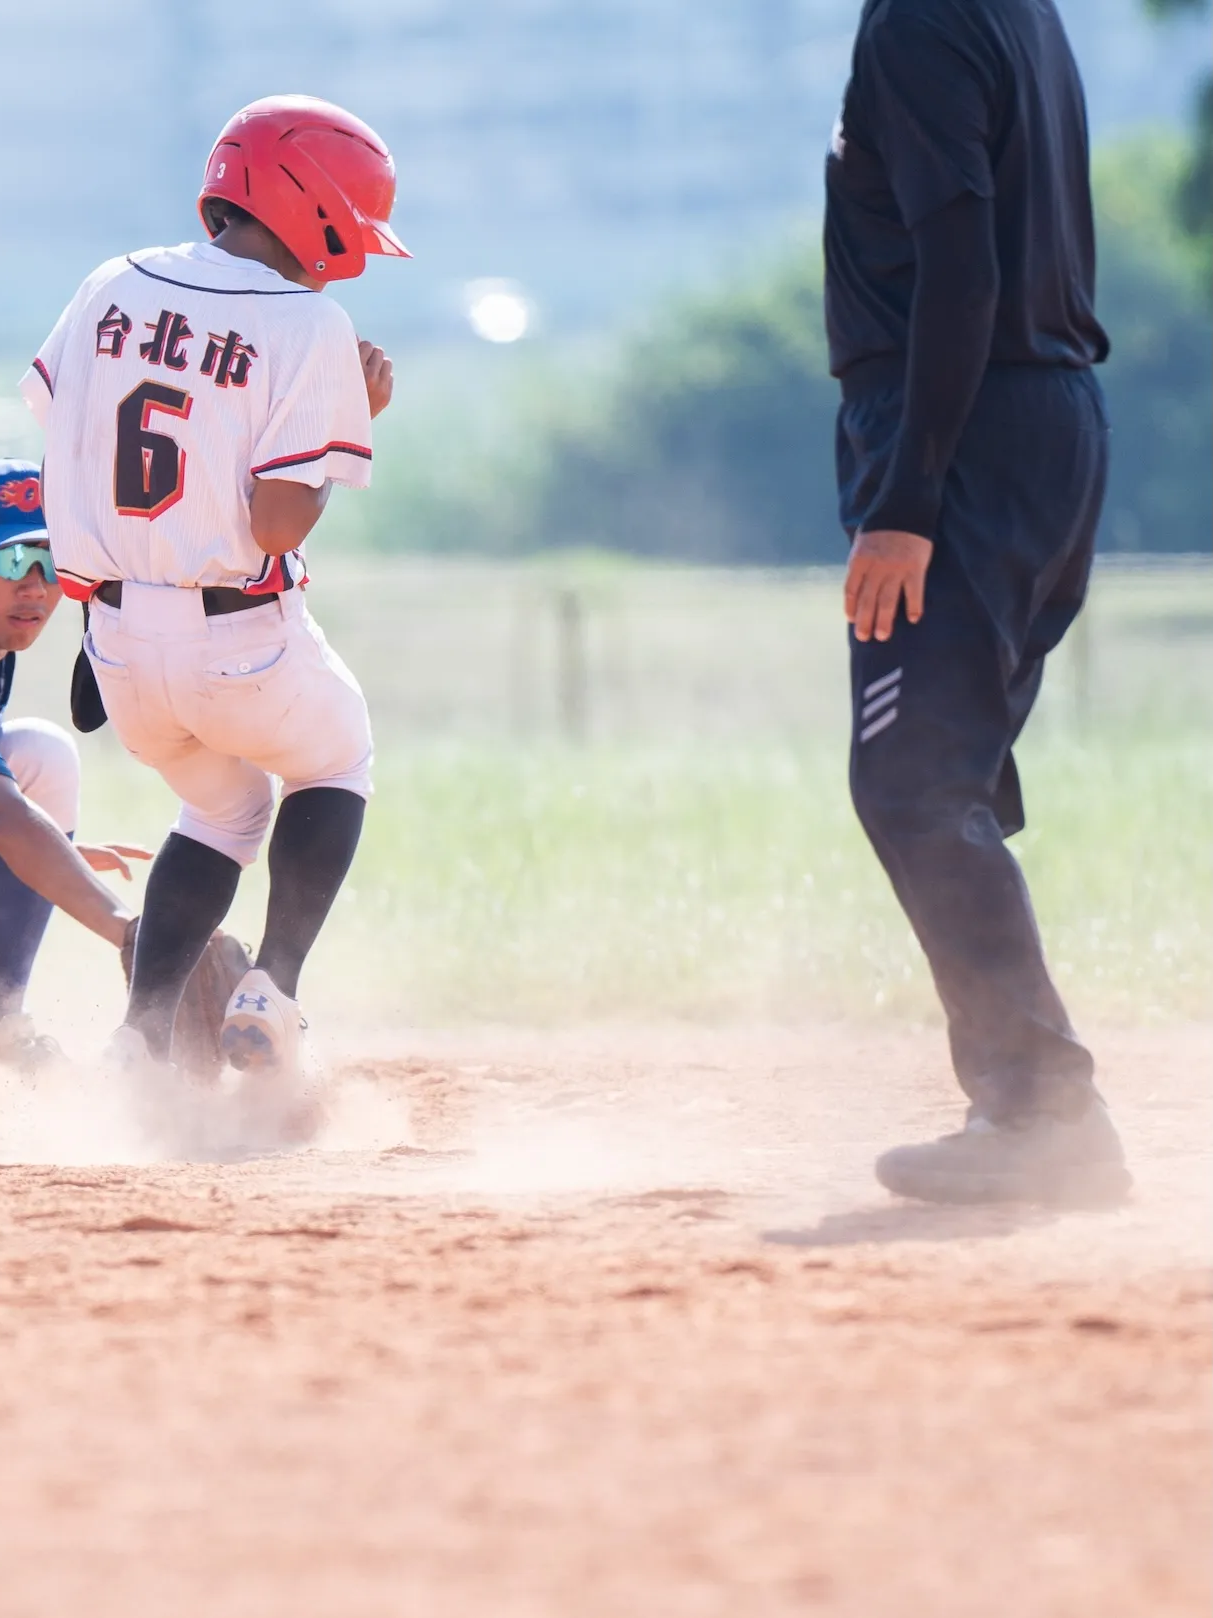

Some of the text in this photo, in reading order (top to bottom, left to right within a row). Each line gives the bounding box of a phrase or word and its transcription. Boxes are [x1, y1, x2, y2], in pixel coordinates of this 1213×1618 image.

[216, 162, 227, 179] 3
[95, 303, 259, 389] 台北市
[112, 377, 194, 523] 6
